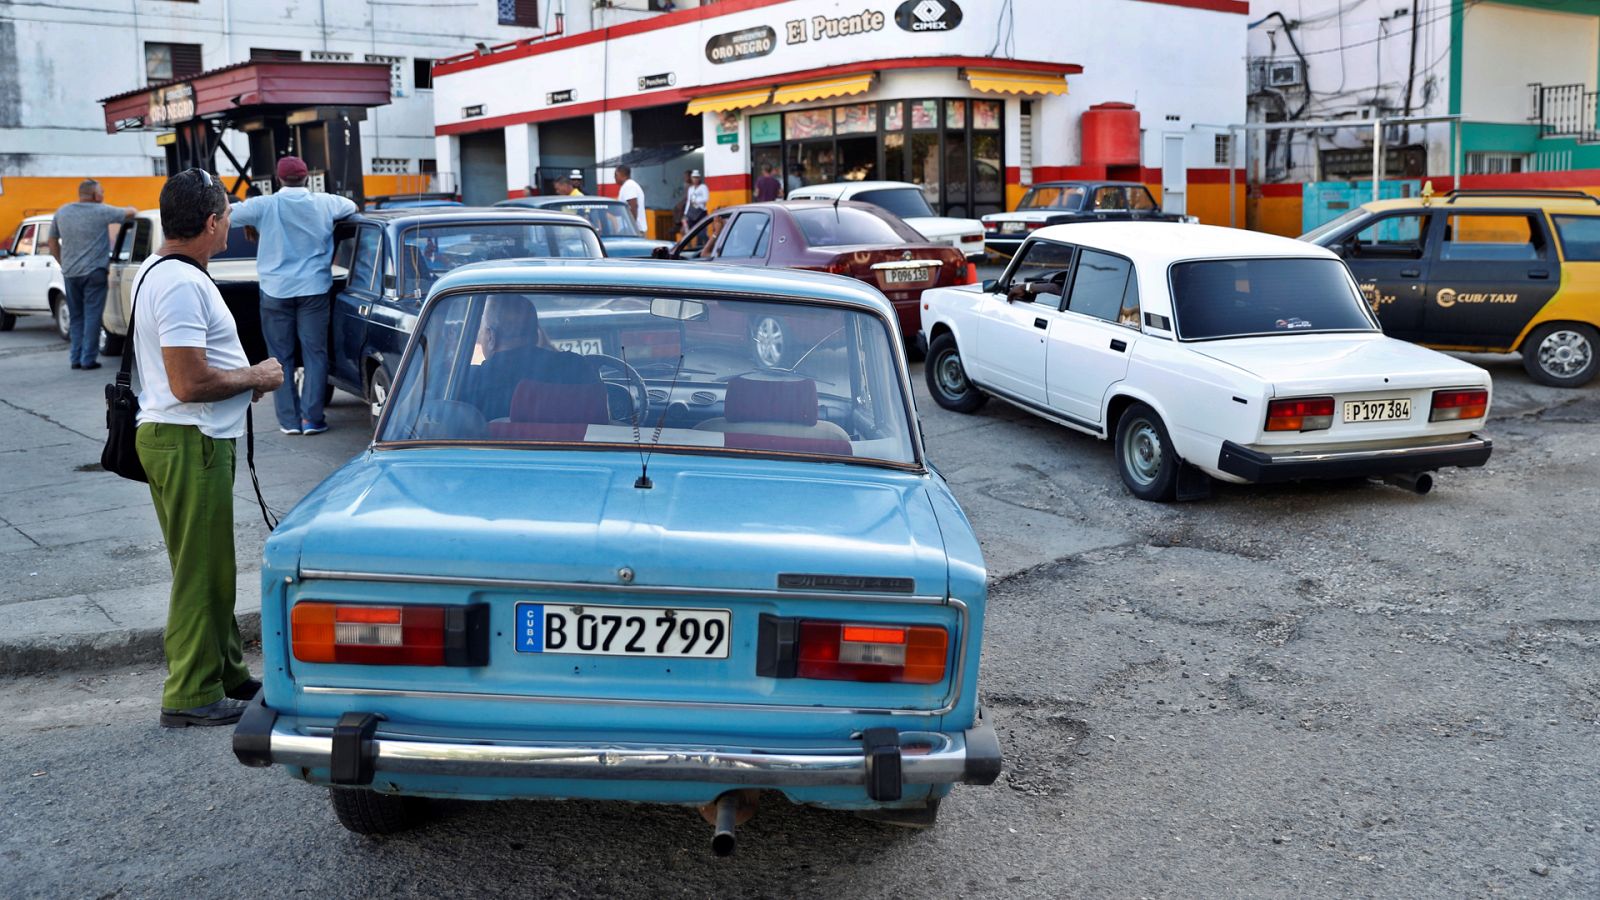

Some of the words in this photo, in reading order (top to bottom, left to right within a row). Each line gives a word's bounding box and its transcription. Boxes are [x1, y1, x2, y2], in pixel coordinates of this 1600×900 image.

[786, 19, 807, 45] El
[812, 8, 885, 41] Puente
[912, 21, 947, 30] CIMEX
[711, 45, 734, 60] ORO
[735, 38, 771, 56] NEGRO
[167, 99, 194, 121] NEGRO
[1490, 294, 1517, 303] TAXI
